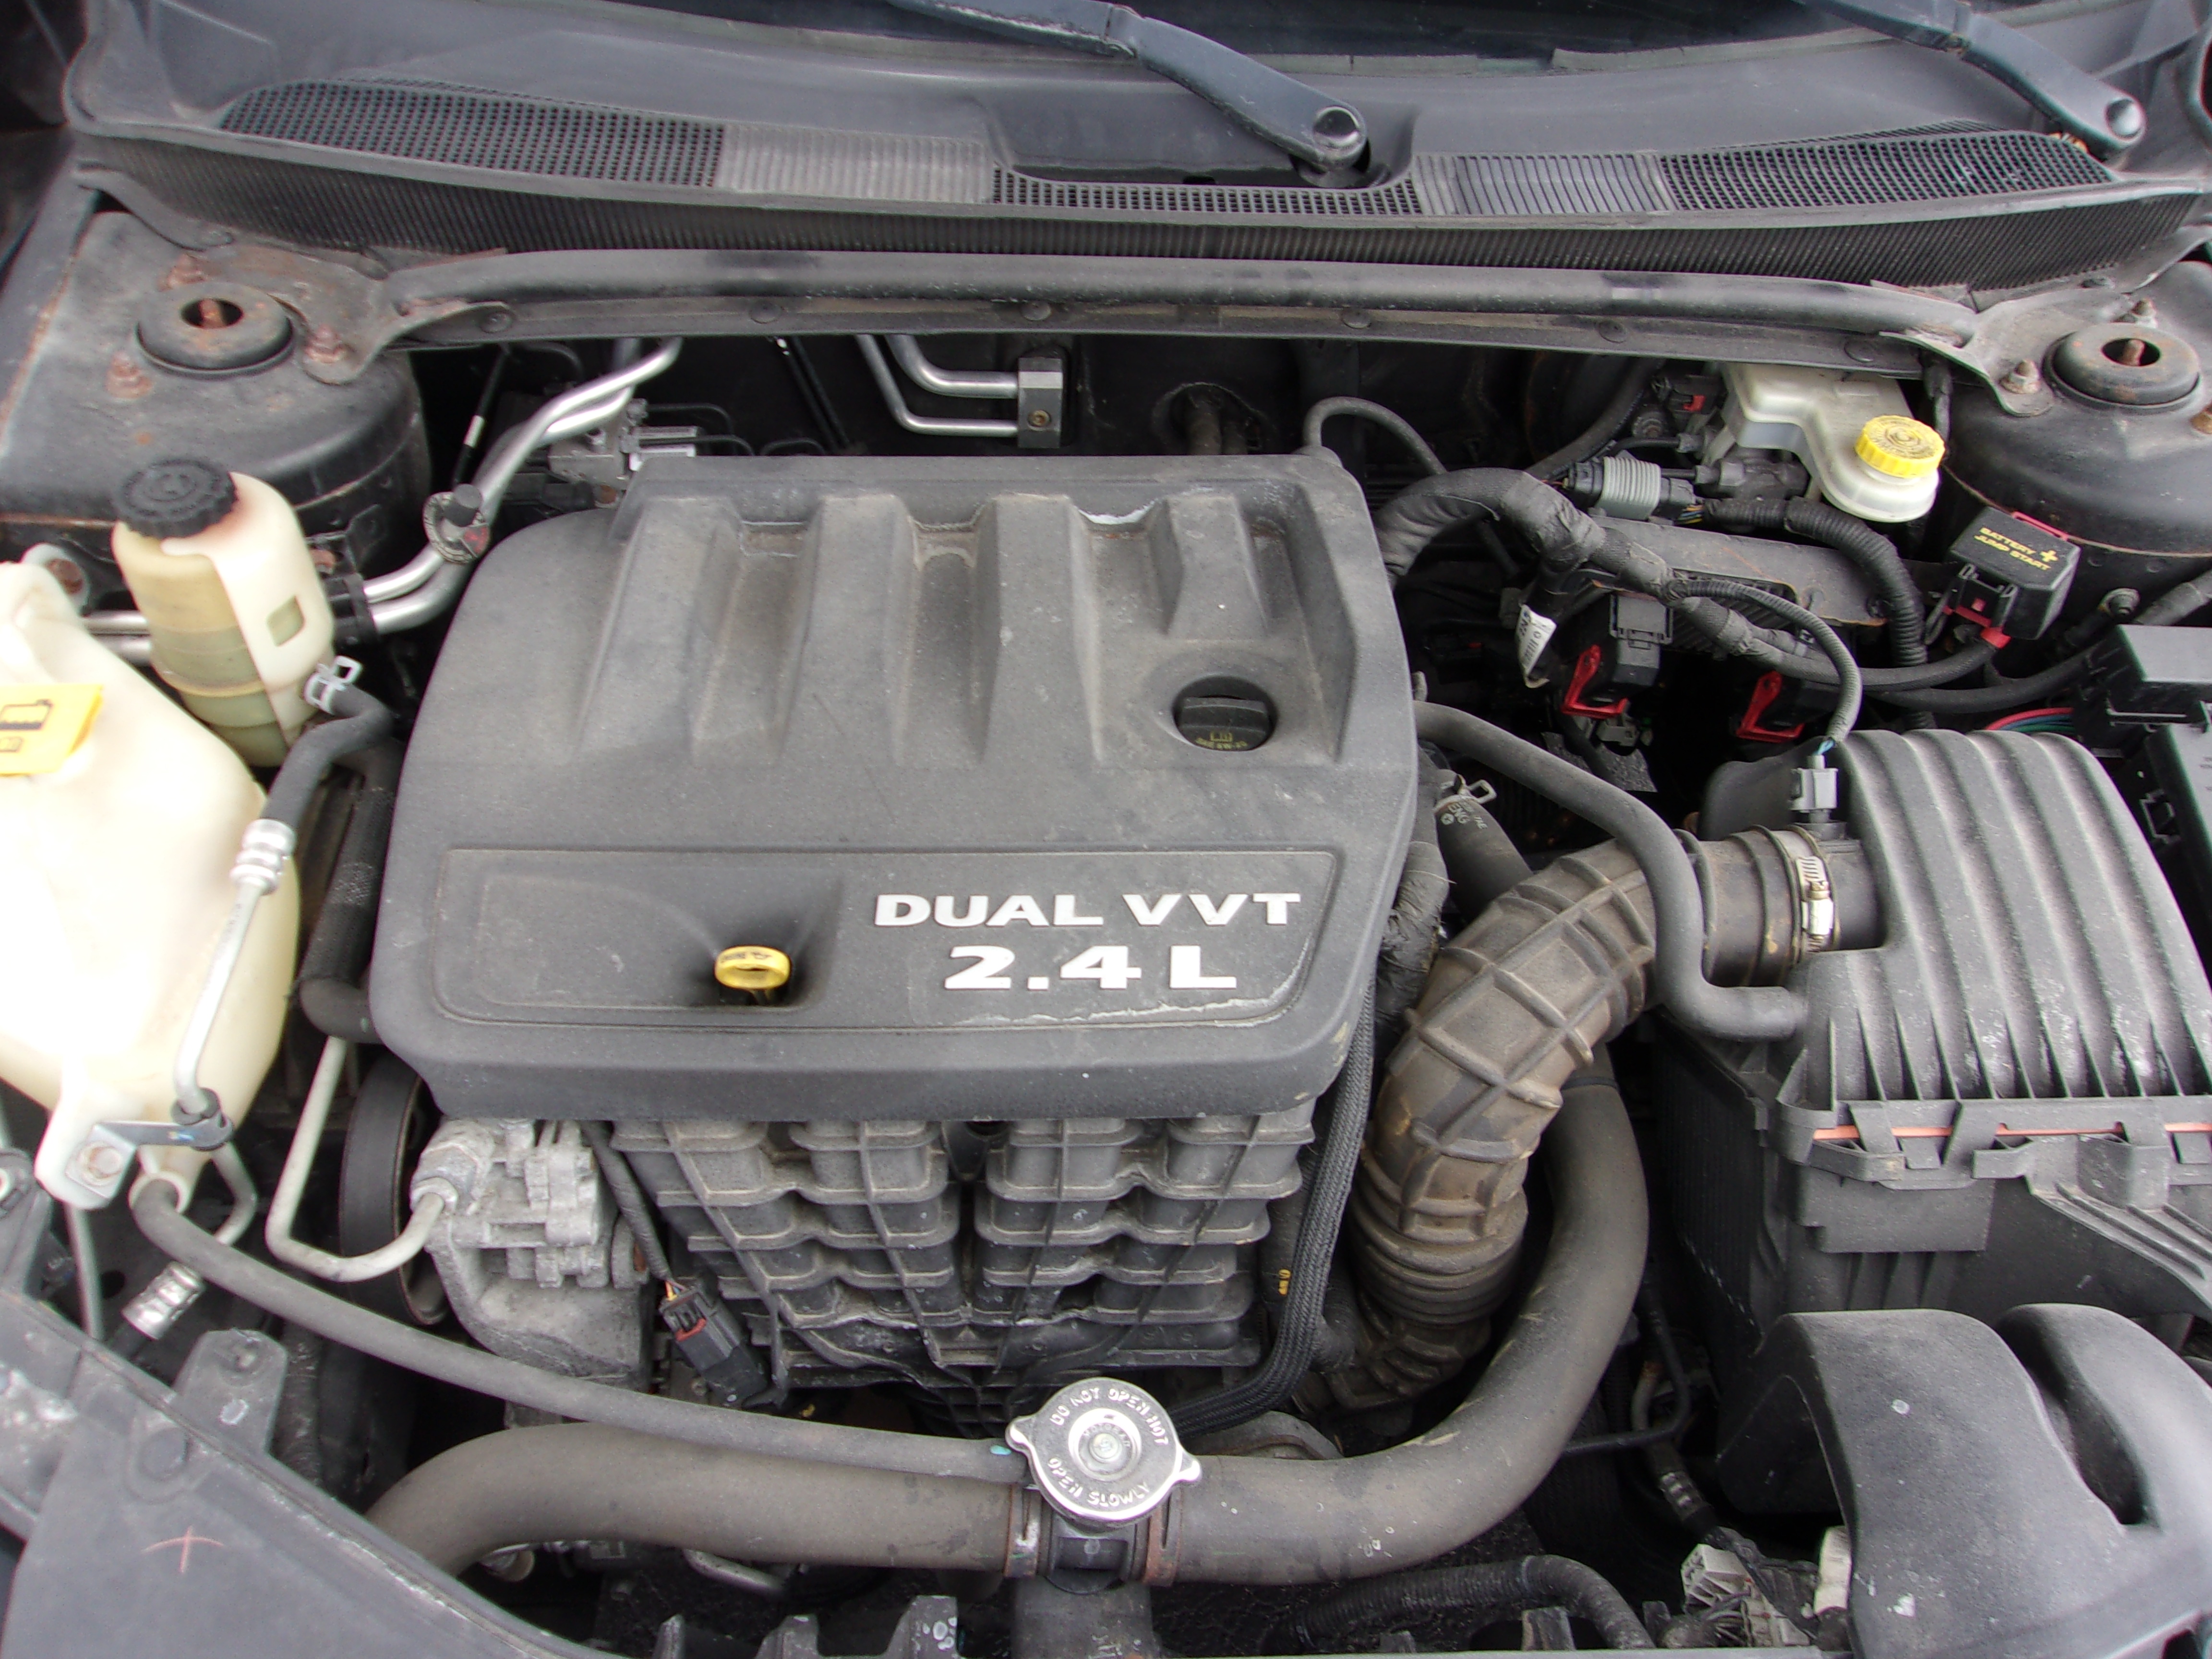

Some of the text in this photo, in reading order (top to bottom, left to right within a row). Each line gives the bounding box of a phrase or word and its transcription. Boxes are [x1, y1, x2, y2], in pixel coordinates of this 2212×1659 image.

[1974, 535, 2052, 570] JUMP START
[1979, 528, 2036, 555] BATTERY
[874, 893, 1301, 927] DUAL VVT
[944, 945, 1237, 989] 2.4 L
[1049, 1387, 1169, 1445] DO NOT OPEN HOT
[1047, 1457, 1150, 1507] OPEN SLOWLY
